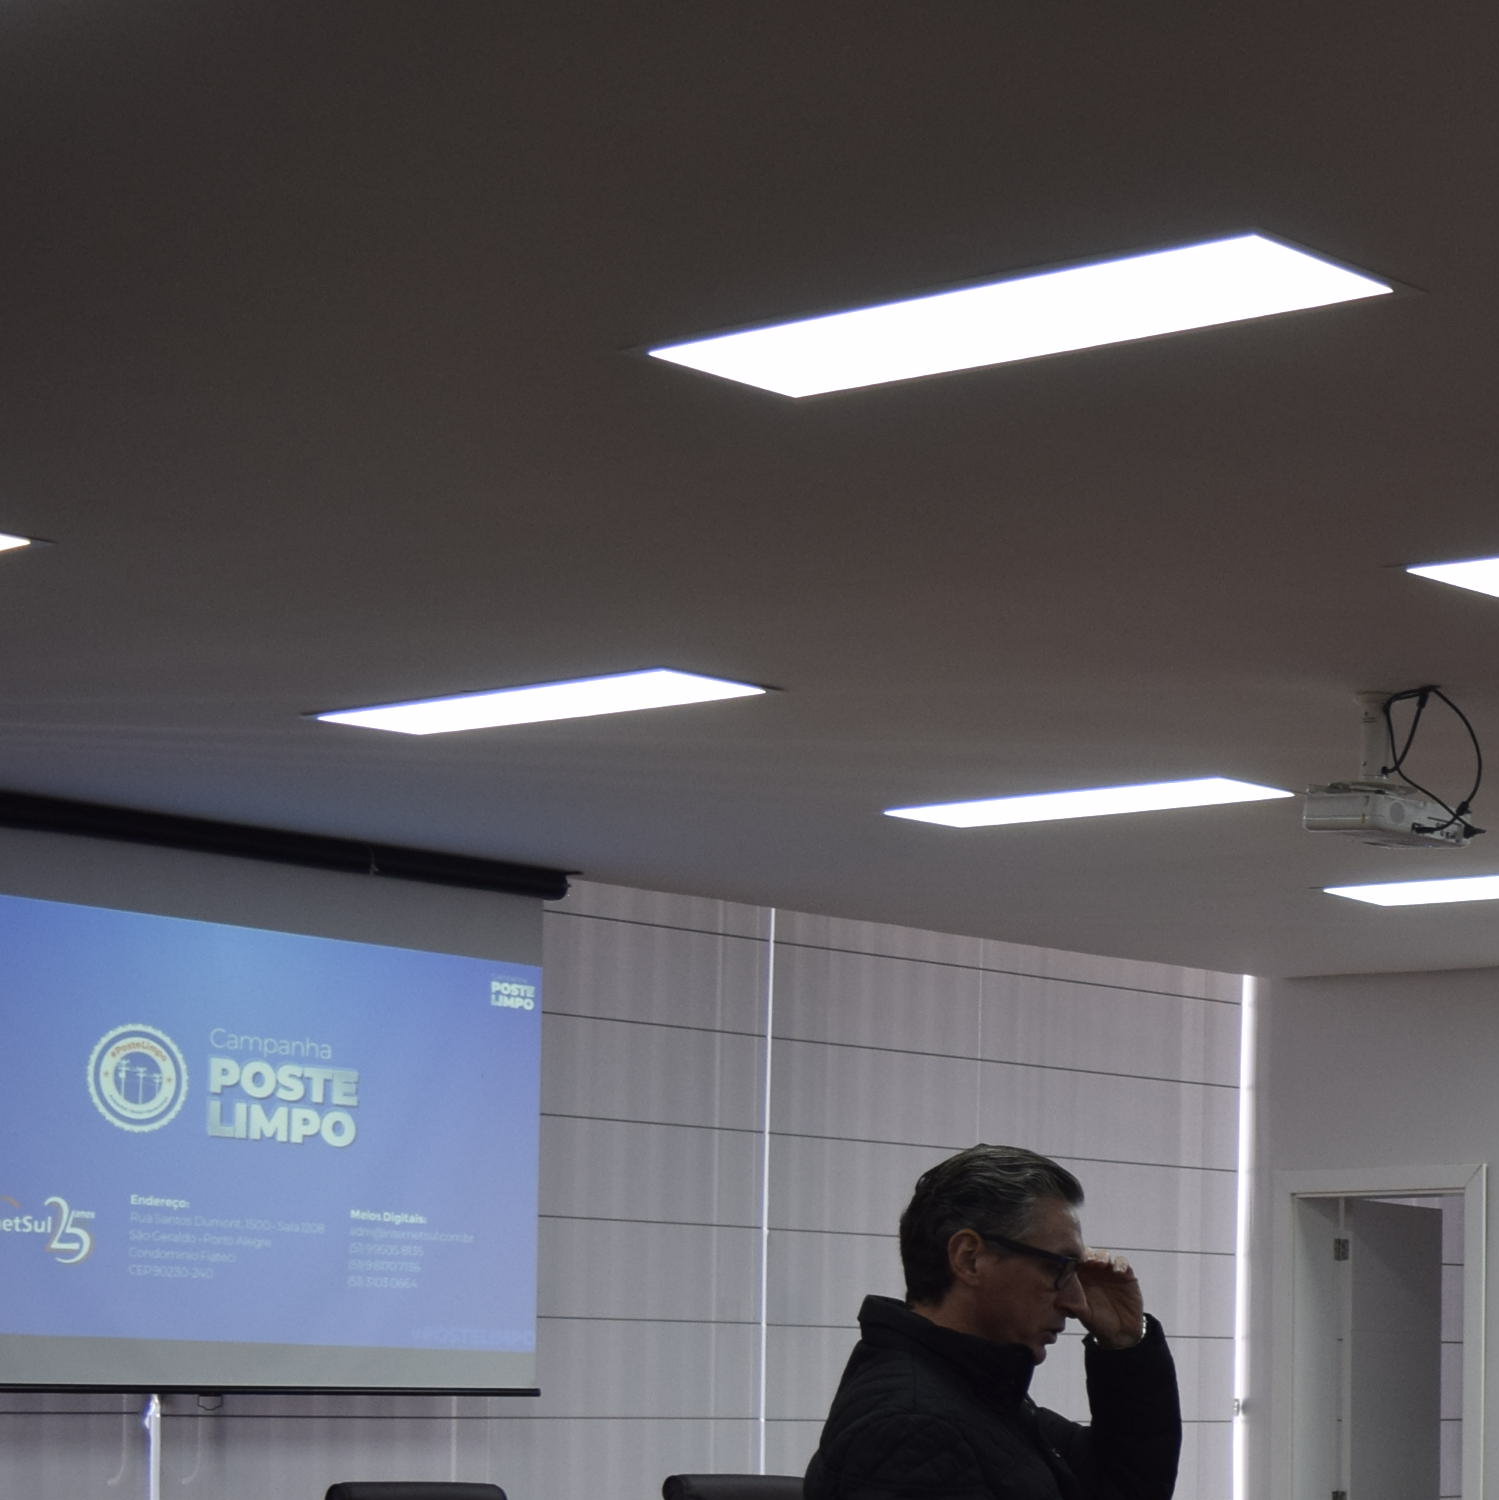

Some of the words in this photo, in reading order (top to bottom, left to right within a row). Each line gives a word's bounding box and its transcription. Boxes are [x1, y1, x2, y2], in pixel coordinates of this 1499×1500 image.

[491, 981, 535, 998] POSTE
[491, 994, 534, 1011] LIMPO
[209, 1028, 332, 1059] Campanha
[208, 1056, 359, 1107] POSTE
[207, 1097, 356, 1148] LIMPO
[350, 1209, 382, 1222] Meios
